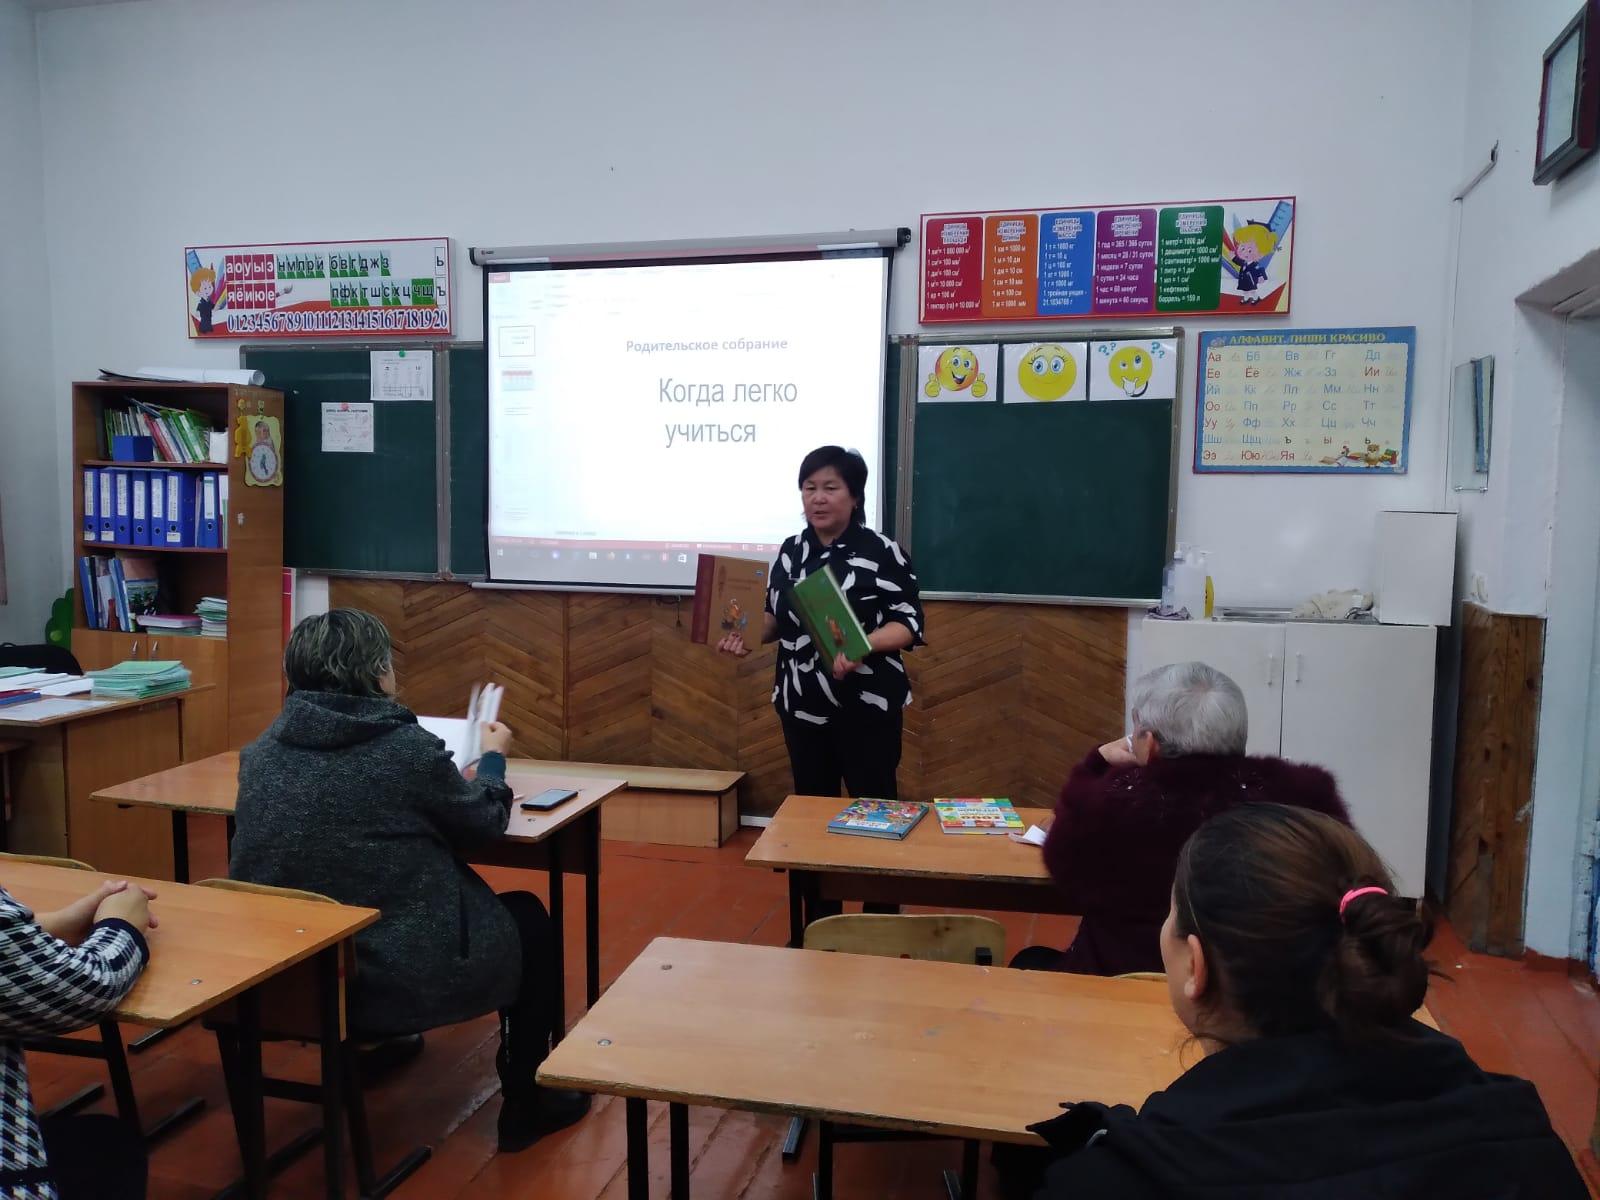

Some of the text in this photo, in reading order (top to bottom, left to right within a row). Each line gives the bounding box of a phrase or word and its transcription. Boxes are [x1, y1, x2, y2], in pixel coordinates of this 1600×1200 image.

[625, 338, 788, 355] Родительское собрание
[1330, 333, 1386, 343] КРАСИВО
[659, 377, 798, 407] Когда легко
[665, 423, 756, 449] учиться
